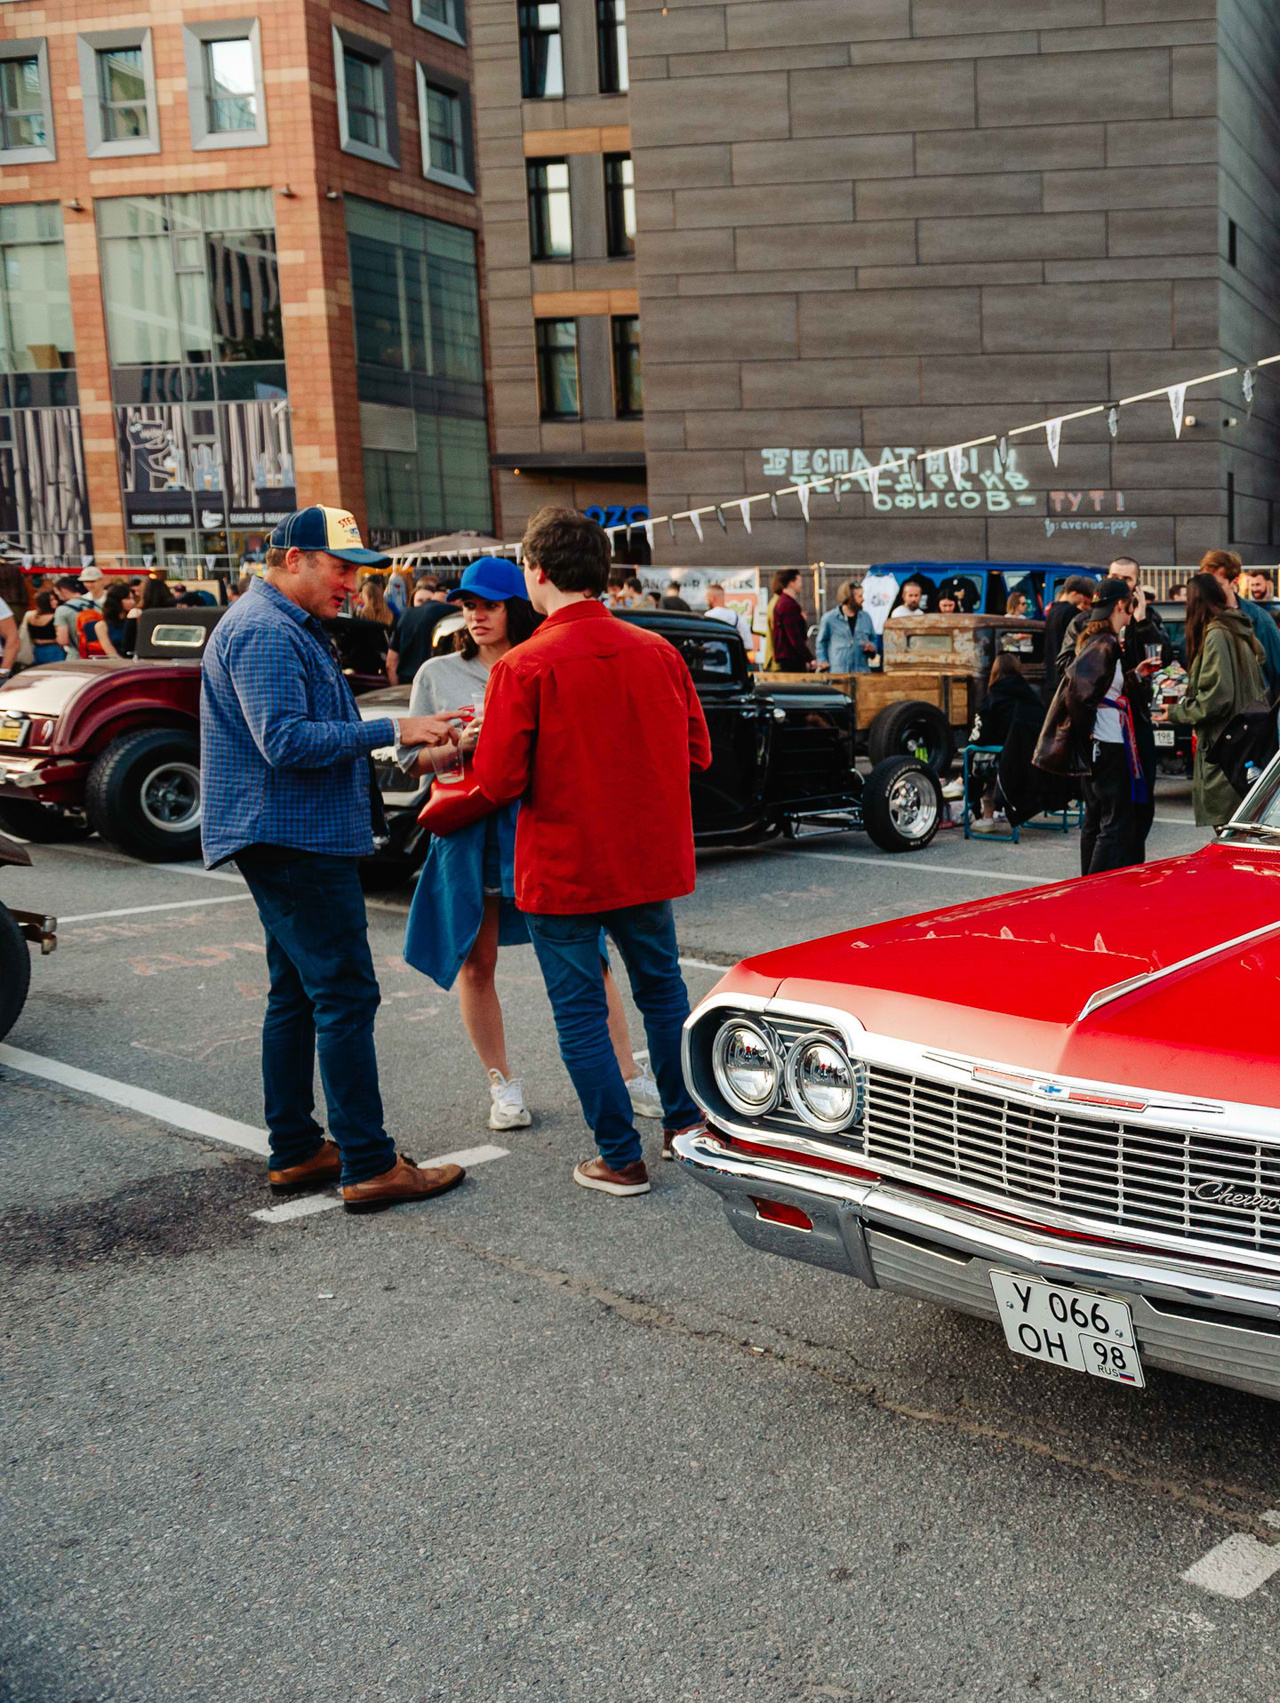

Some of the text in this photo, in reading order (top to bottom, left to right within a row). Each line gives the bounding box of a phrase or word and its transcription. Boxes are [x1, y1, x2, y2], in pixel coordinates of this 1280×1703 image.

[1048, 1292, 1110, 1334] 066
[1093, 1341, 1127, 1370] 98
[1097, 1365, 1120, 1378] RUS
